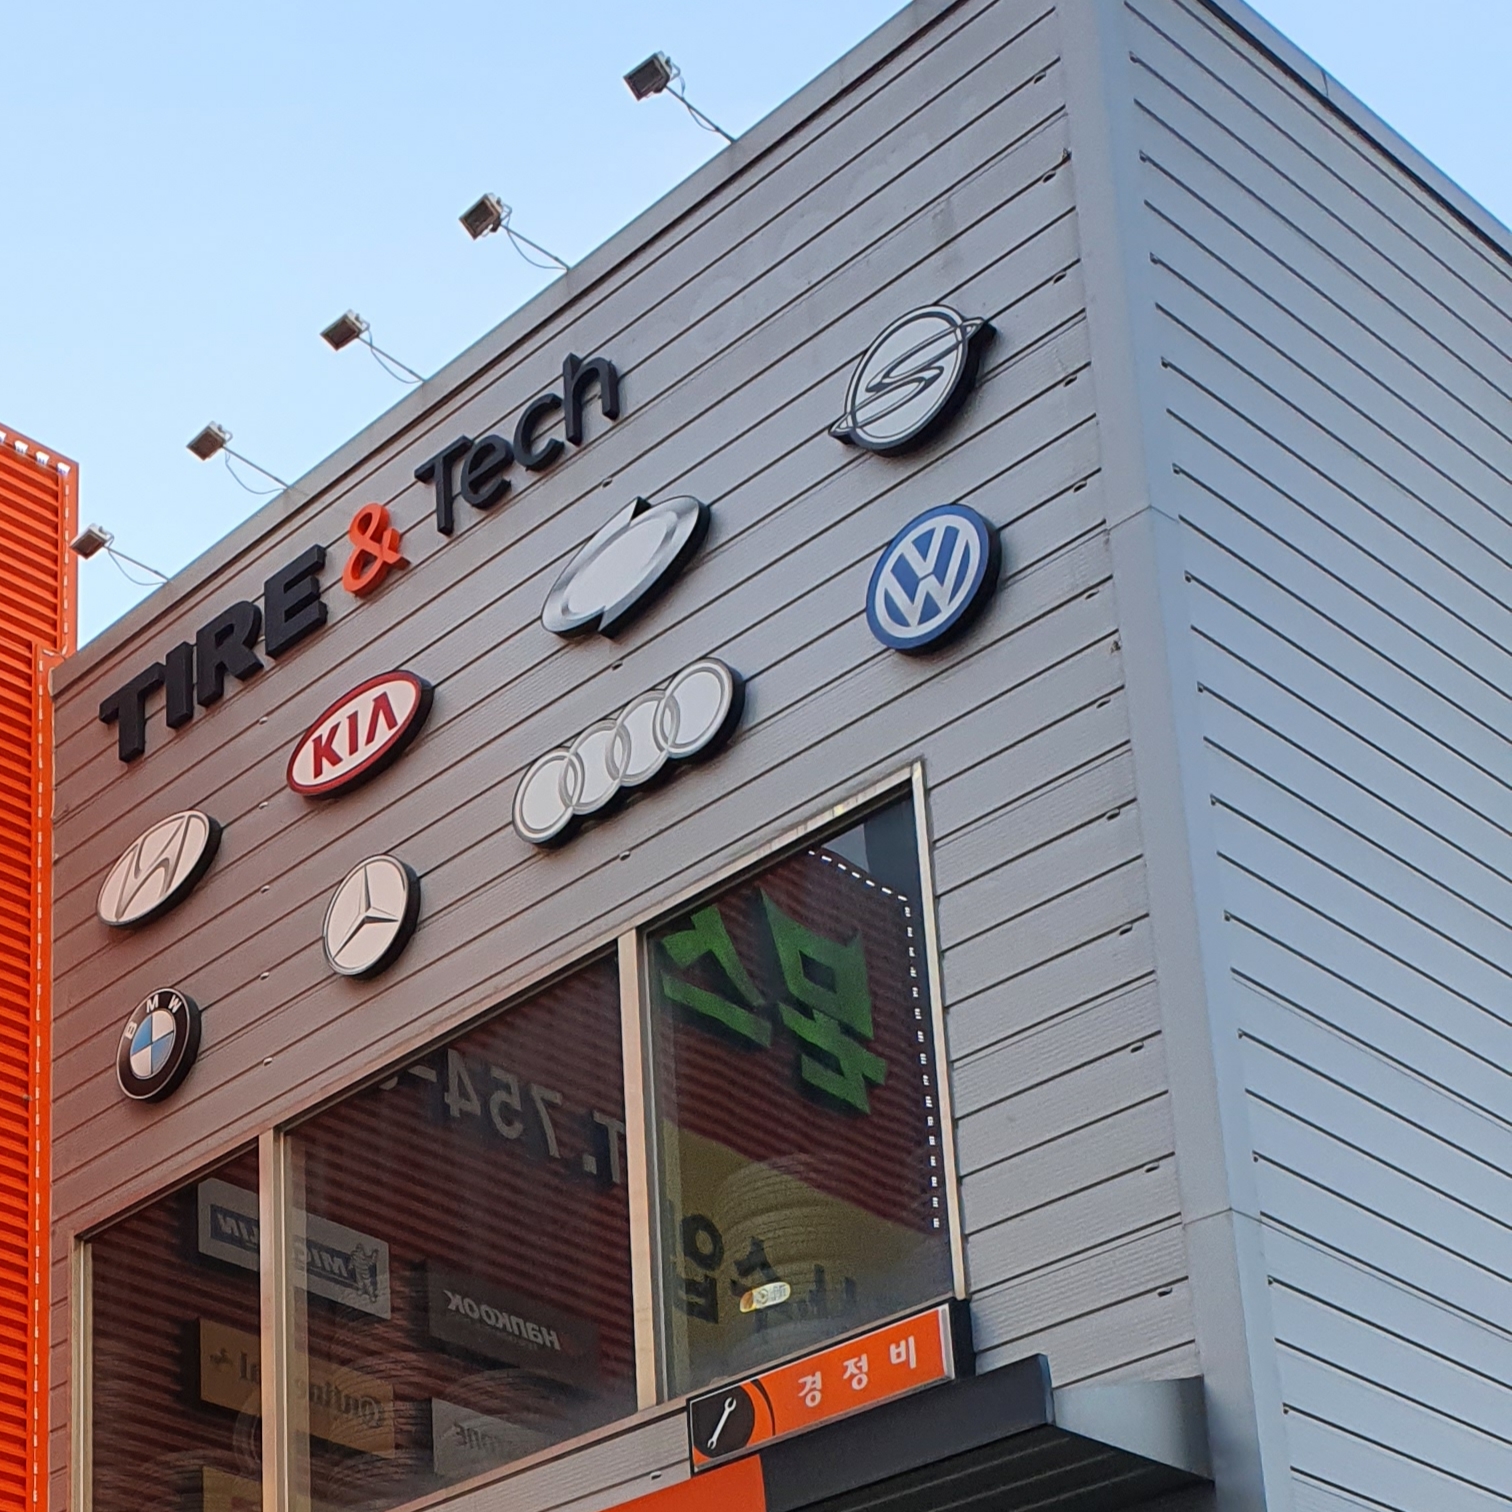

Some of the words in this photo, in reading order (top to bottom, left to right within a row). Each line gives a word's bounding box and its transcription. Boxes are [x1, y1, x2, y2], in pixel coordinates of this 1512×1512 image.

[99, 543, 328, 763] TIRE
[341, 502, 410, 596] &
[414, 352, 619, 535] Tech
[311, 689, 400, 783] KIA
[124, 993, 182, 1040] BMW
